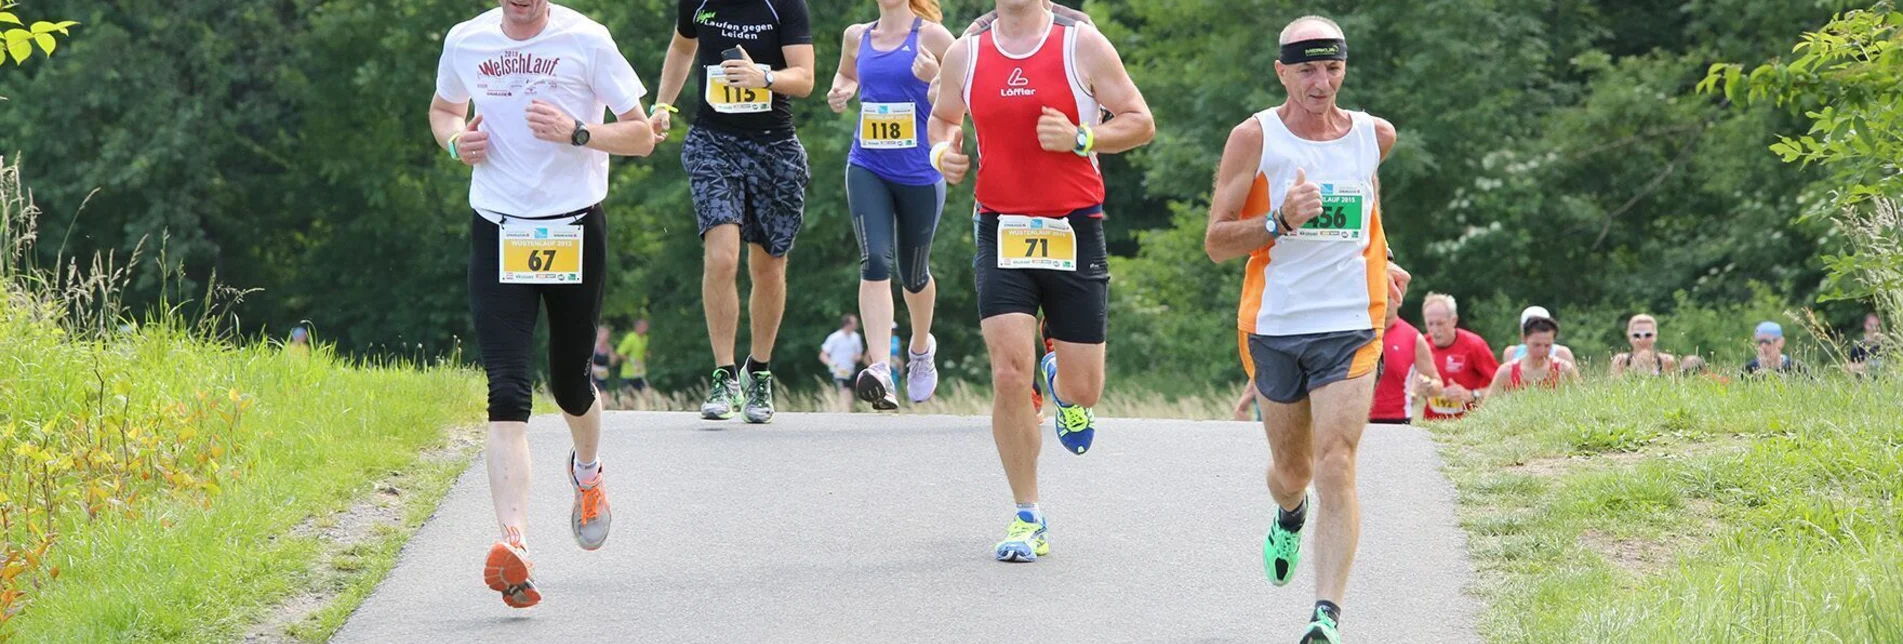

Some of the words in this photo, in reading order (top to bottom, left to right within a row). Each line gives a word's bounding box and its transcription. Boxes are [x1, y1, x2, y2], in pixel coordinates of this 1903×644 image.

[704, 19, 740, 31] Laufen
[742, 24, 774, 33] gegen
[721, 29, 758, 40] Leiden
[723, 85, 756, 103] 115
[1000, 87, 1036, 97] Löffler
[871, 122, 901, 139] 118
[1025, 238, 1048, 257] 71
[528, 250, 557, 271] 67
